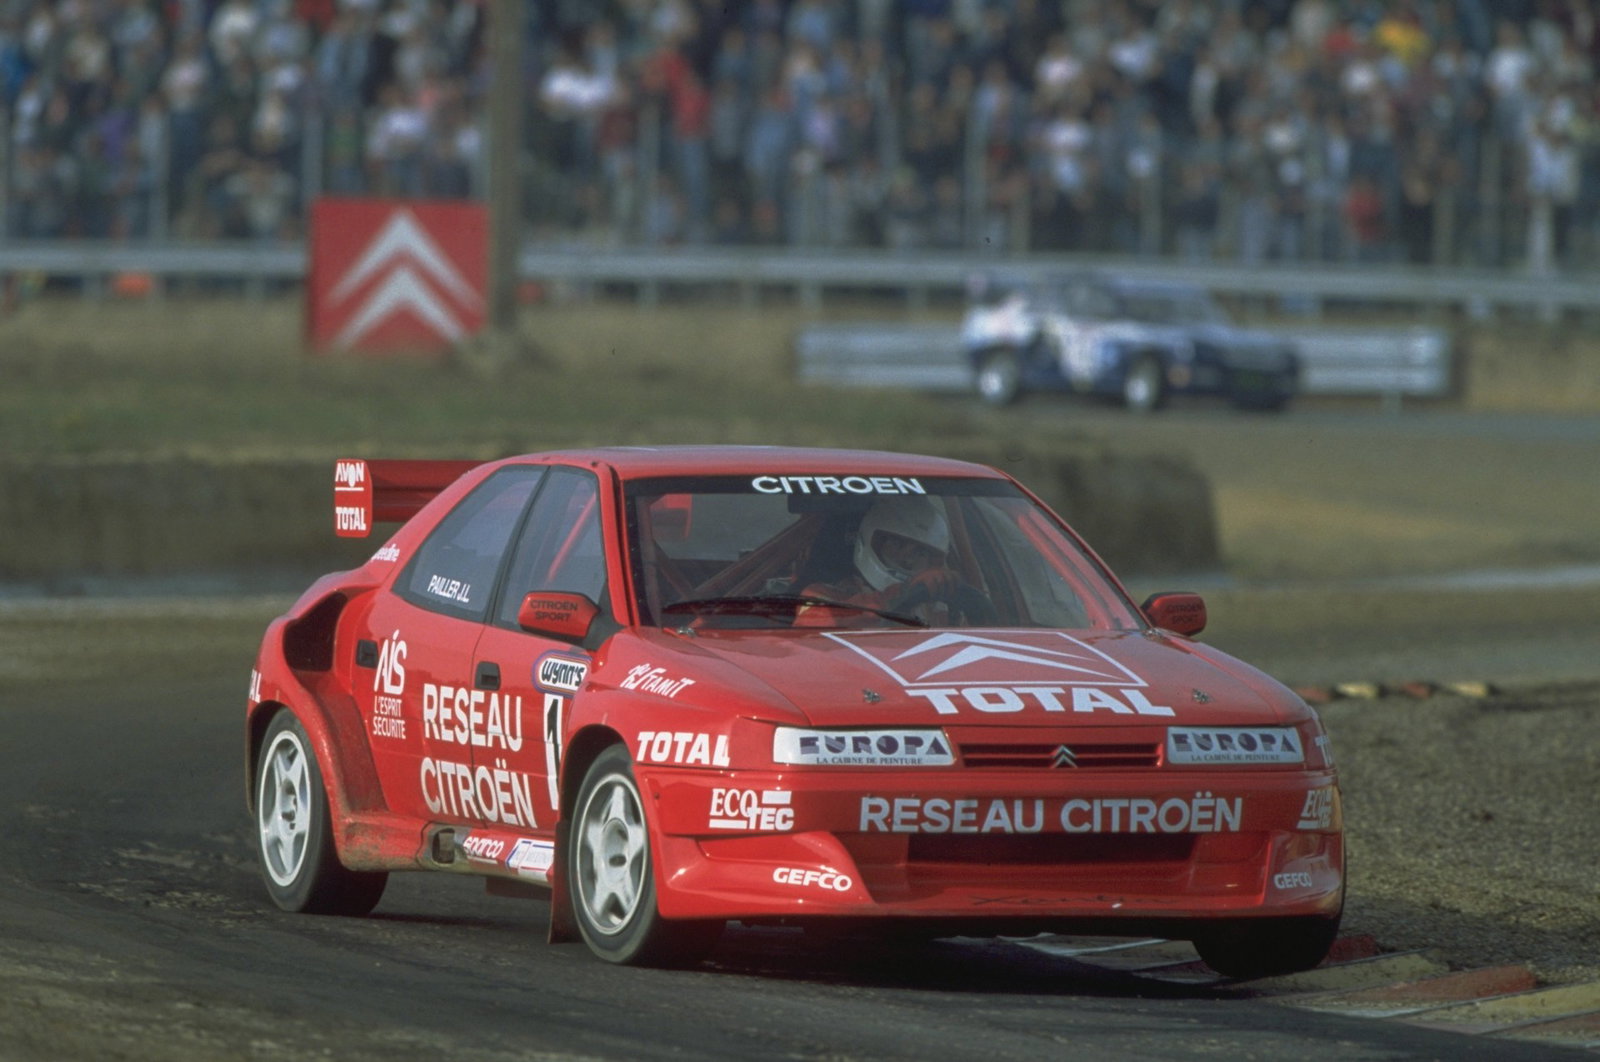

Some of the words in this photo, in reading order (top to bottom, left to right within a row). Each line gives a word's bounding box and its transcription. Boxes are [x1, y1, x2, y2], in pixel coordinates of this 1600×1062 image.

[335, 463, 364, 487] AVON
[752, 476, 925, 496] CITROEN
[336, 507, 367, 531] TOTAL
[427, 574, 461, 599] PAILLER
[534, 612, 571, 621] SPORT
[374, 695, 402, 717] L'ESPRIT
[908, 688, 1176, 716] TOTAL
[422, 682, 523, 752] RESEAU
[636, 731, 731, 767] TOTAL
[800, 735, 948, 755] EUROPA
[1171, 732, 1297, 753] EUROPA
[420, 757, 538, 829] CITROËN
[711, 788, 758, 817] ECO
[749, 806, 795, 831] TEC
[860, 797, 1044, 834] RESEAU
[1060, 791, 1243, 833] CITROËN
[773, 867, 852, 892] GEFCO
[1273, 872, 1312, 889] GEFCO
